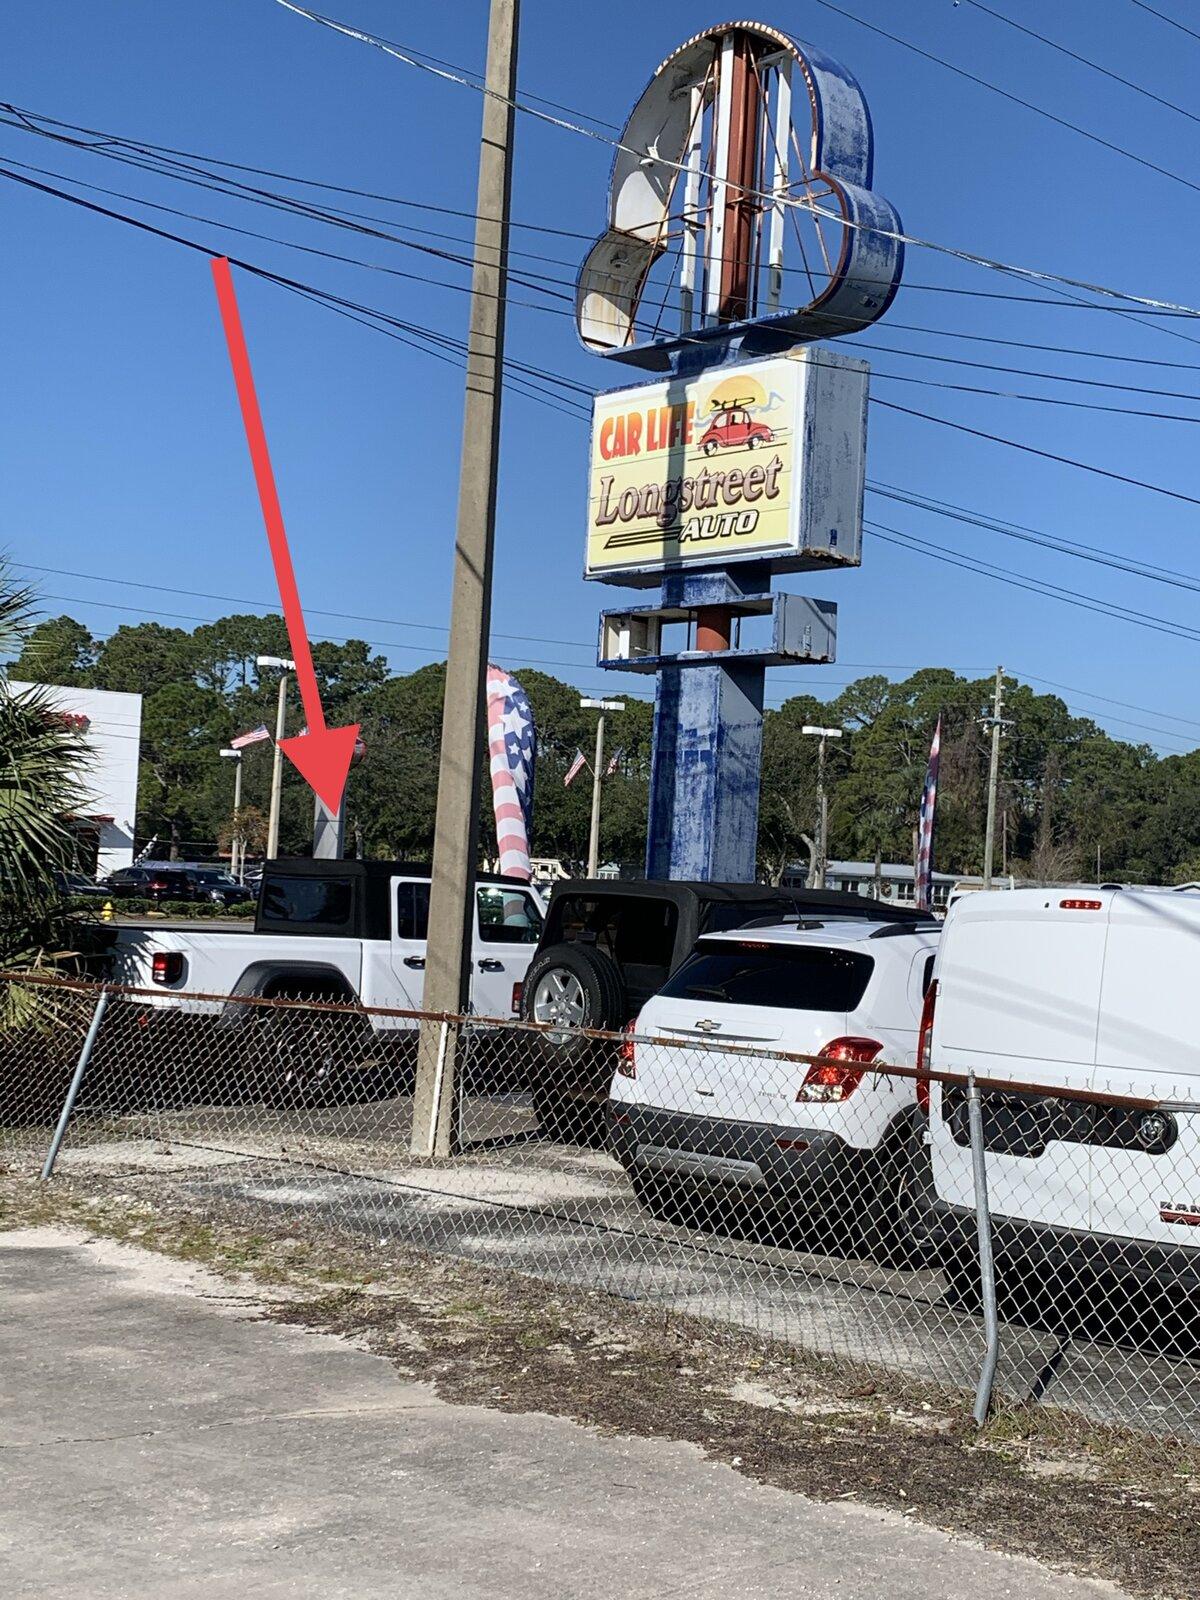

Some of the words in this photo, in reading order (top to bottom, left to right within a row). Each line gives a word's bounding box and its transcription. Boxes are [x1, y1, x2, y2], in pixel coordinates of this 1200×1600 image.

[600, 412, 643, 461] CAR
[646, 401, 696, 452] LIFE
[595, 454, 783, 528] Longstreet
[678, 508, 760, 544] AUTO
